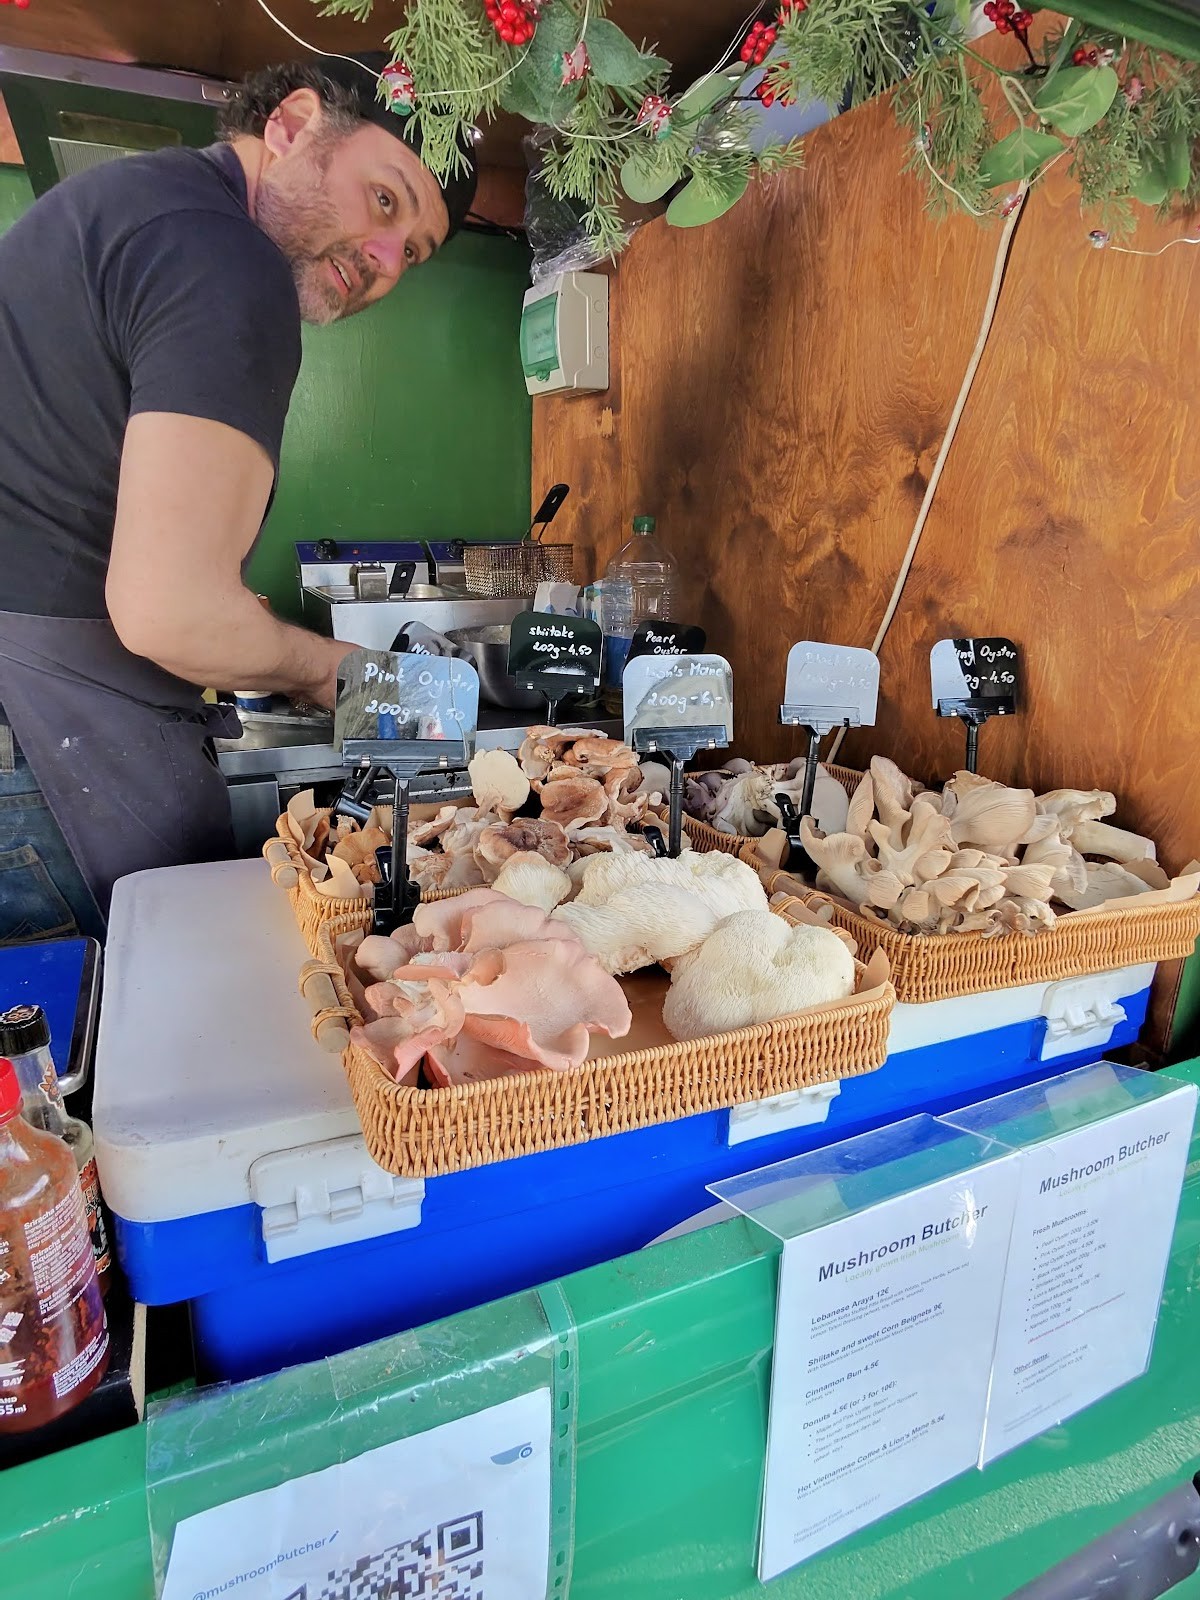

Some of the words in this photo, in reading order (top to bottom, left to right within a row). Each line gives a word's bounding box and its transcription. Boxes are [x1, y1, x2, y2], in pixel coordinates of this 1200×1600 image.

[529, 625, 575, 639] shiitake
[645, 630, 676, 645] Pearl
[653, 645, 688, 655] Oyster
[980, 645, 1016, 663] Oyster
[364, 662, 405, 683] Pink
[418, 670, 475, 699] Oyster
[1039, 1155, 1114, 1194] Mushroom
[1119, 1132, 1170, 1161] Butcher
[819, 1235, 915, 1282] Mushroom
[921, 1205, 989, 1241] Butcher
[1033, 1225, 1050, 1236] Fresh
[812, 1305, 850, 1325] Lebanese
[852, 1295, 873, 1308] Araya
[877, 1287, 889, 1297] 12€
[808, 1350, 839, 1367] Shiitake
[841, 1340, 855, 1352] and
[858, 1331, 879, 1345] sweet
[881, 1323, 899, 1334] Corn
[901, 1309, 932, 1326] Beignets
[934, 1302, 942, 1311] 9€
[3, 1376, 23, 1387] BAY
[805, 1377, 844, 1398] Cinnamon
[847, 1369, 862, 1380] Bun
[864, 1360, 879, 1371] 4.5€
[803, 1414, 830, 1430] Donuts
[832, 1403, 848, 1415] 4.5€
[850, 1399, 860, 1409] (or
[868, 1390, 878, 1398] for
[798, 1483, 811, 1494] Hot
[813, 1461, 855, 1485] Vietnamese
[857, 1448, 880, 1463] Coffee
[889, 1433, 910, 1447] Lion's
[912, 1423, 929, 1435] Mane
[192, 1537, 327, 1600] @mushroombutcher
